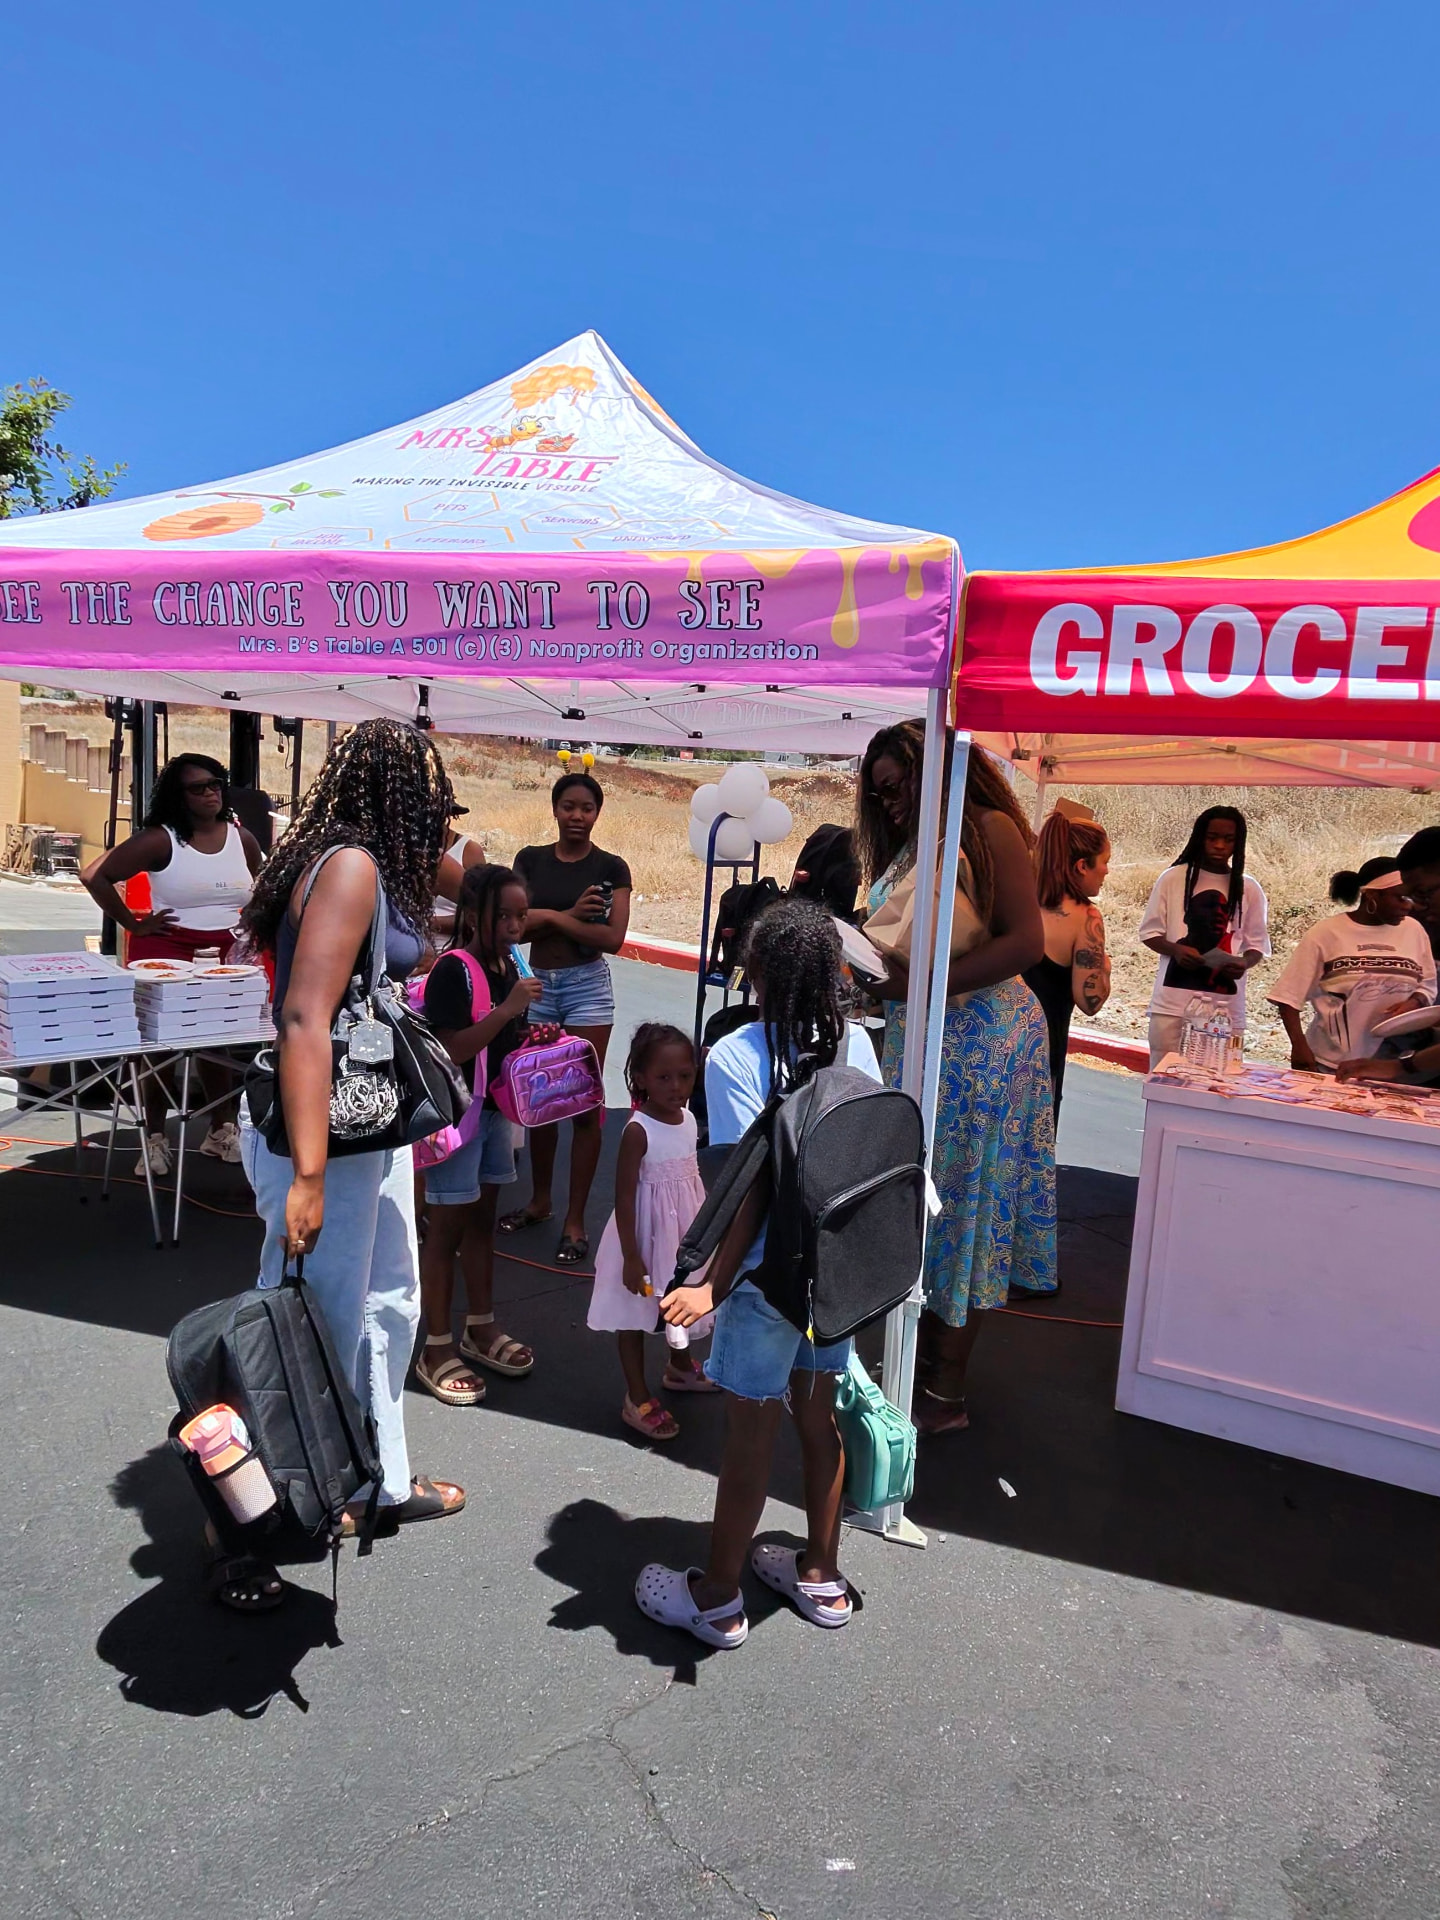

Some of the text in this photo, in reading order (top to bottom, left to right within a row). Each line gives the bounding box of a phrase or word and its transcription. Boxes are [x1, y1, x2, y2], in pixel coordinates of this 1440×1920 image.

[396, 426, 499, 450] MRS
[471, 449, 620, 483] TABLE
[352, 477, 599, 493] MAKING THE INVISIBLE VISIBLE
[433, 503, 470, 512] PETS
[541, 516, 601, 525] SENIORS
[0, 578, 765, 631] EE THE CHANGE YOU WANT TO SEE
[238, 635, 282, 654] Mrs.
[325, 636, 385, 655] Table
[390, 637, 406, 656] A
[411, 638, 448, 656] 501
[528, 638, 643, 664] Nonprofit
[649, 639, 819, 665] Organization
[1029, 602, 1440, 700] GROCE
